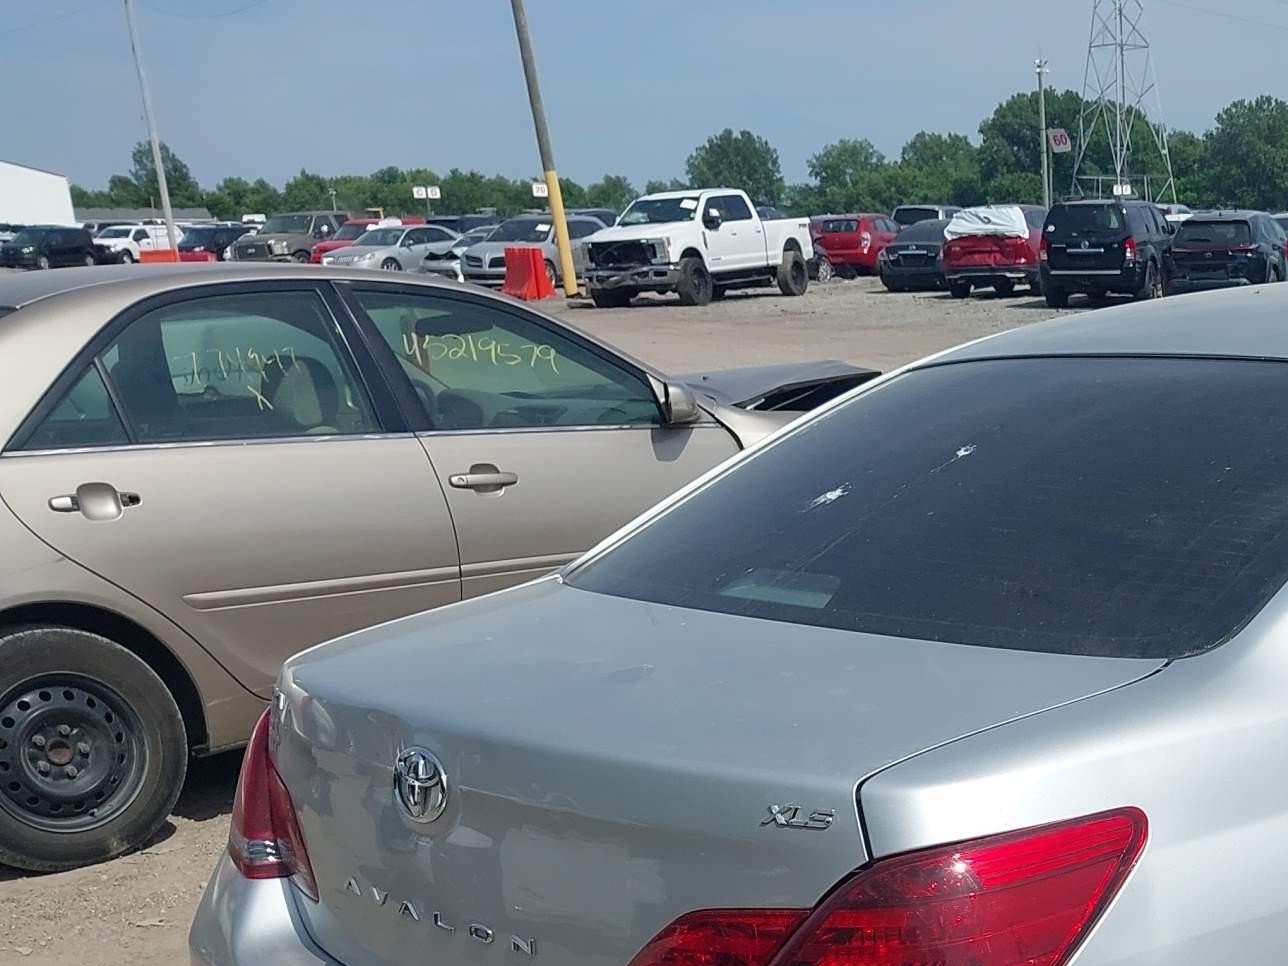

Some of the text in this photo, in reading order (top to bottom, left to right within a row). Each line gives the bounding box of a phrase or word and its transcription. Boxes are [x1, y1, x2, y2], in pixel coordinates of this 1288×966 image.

[1053, 134, 1068, 146] 60
[402, 332, 560, 376] 45219579
[759, 804, 836, 831] XLS
[344, 875, 537, 957] AVALON
